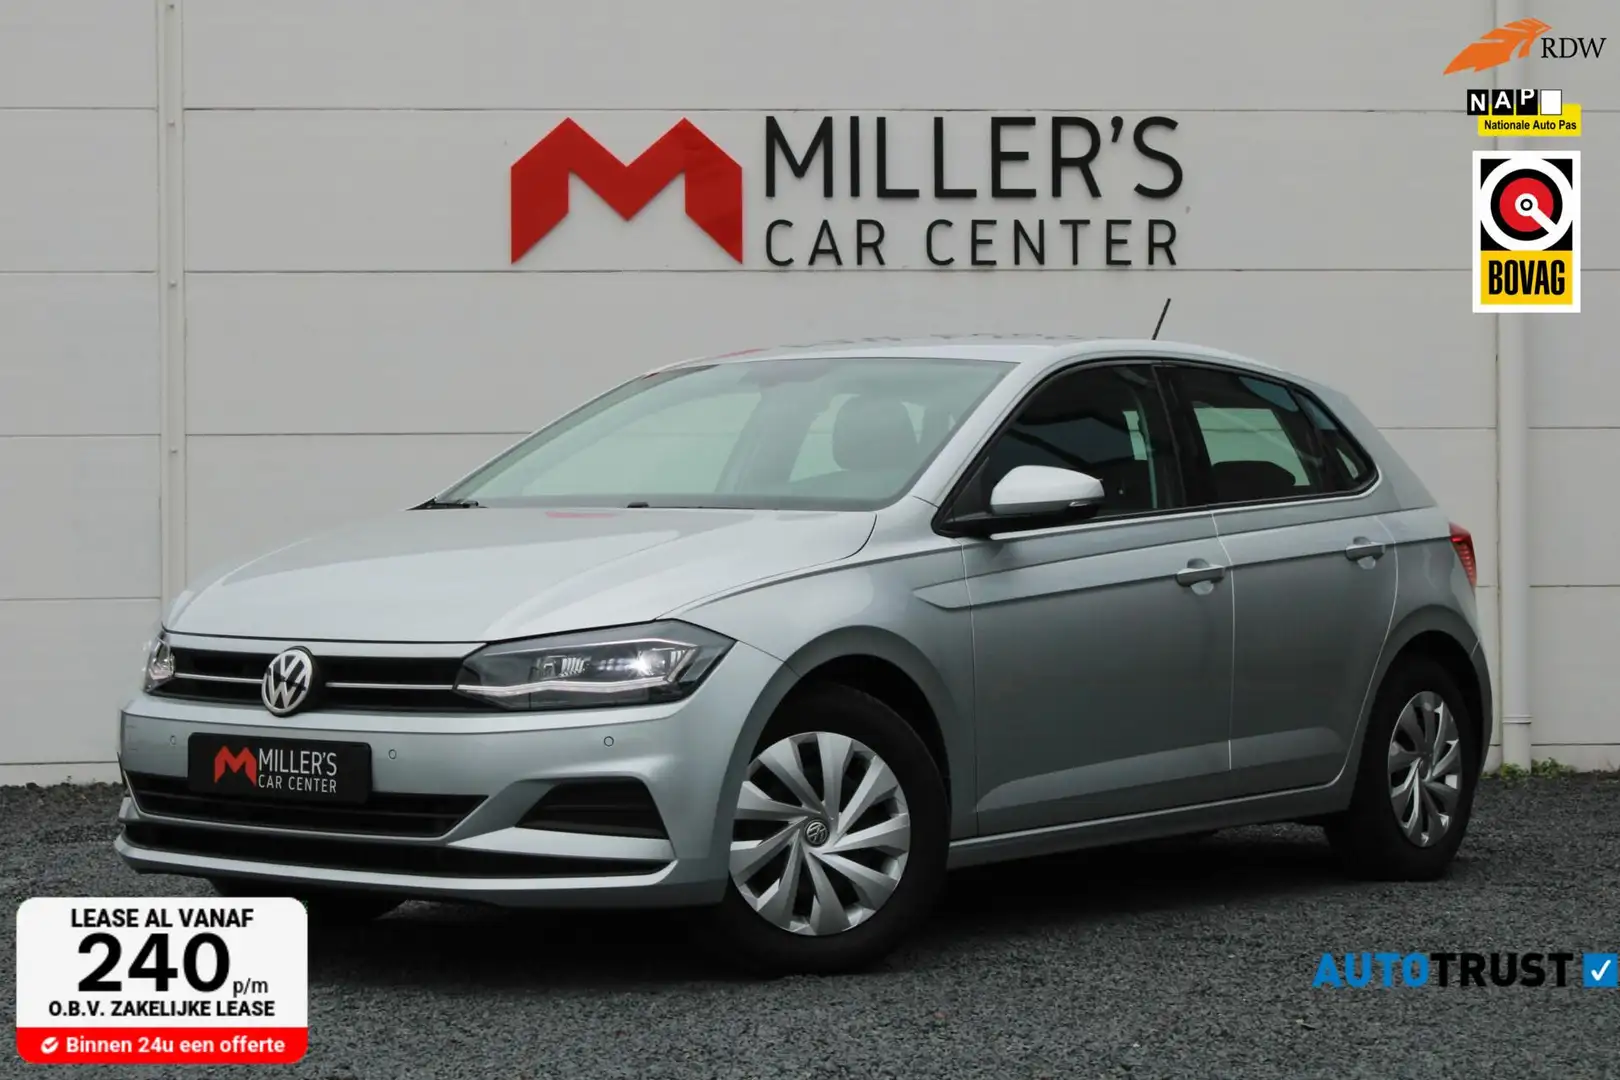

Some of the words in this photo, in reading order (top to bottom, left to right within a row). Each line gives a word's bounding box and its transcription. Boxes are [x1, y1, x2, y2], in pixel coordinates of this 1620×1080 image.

[765, 115, 1184, 199] MILLER'S
[765, 219, 887, 267] CAR
[924, 219, 1178, 267] CENTER
[258, 748, 338, 776] MILLER'S
[258, 774, 283, 789] CAR
[288, 776, 337, 793] CENTER
